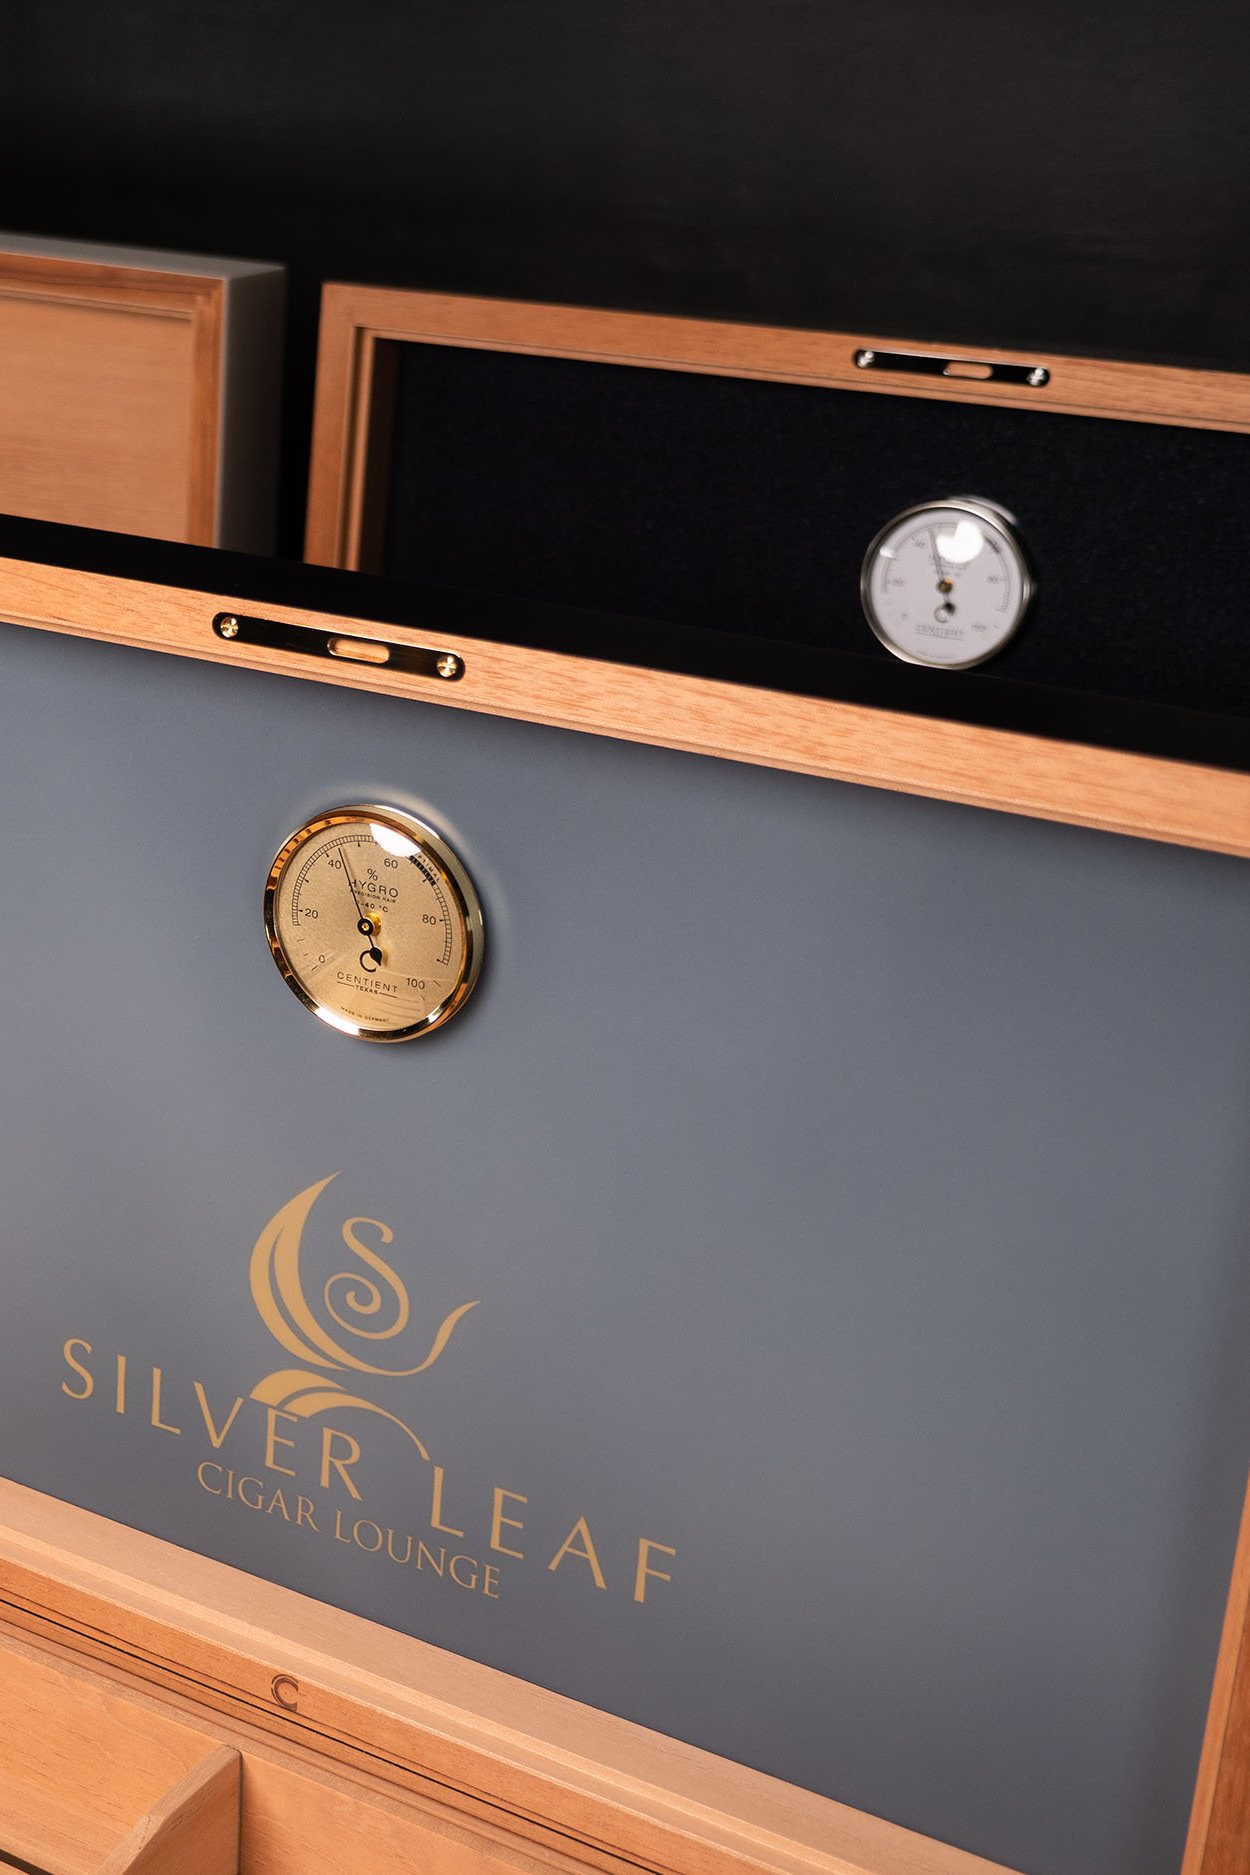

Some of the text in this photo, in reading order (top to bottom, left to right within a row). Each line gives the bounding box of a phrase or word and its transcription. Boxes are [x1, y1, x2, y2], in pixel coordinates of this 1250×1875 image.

[327, 859, 342, 870] 40
[383, 858, 399, 869] 60
[366, 868, 379, 881] %
[304, 908, 319, 919] 20
[421, 914, 437, 926] 80
[318, 954, 327, 964] 0
[336, 971, 398, 993] CENTIENT
[406, 977, 426, 990] 100
[355, 984, 378, 995] TEXAS
[61, 1338, 677, 1604] SILVER LEAF
[197, 1461, 500, 1599] CIGAR LOUNGE
